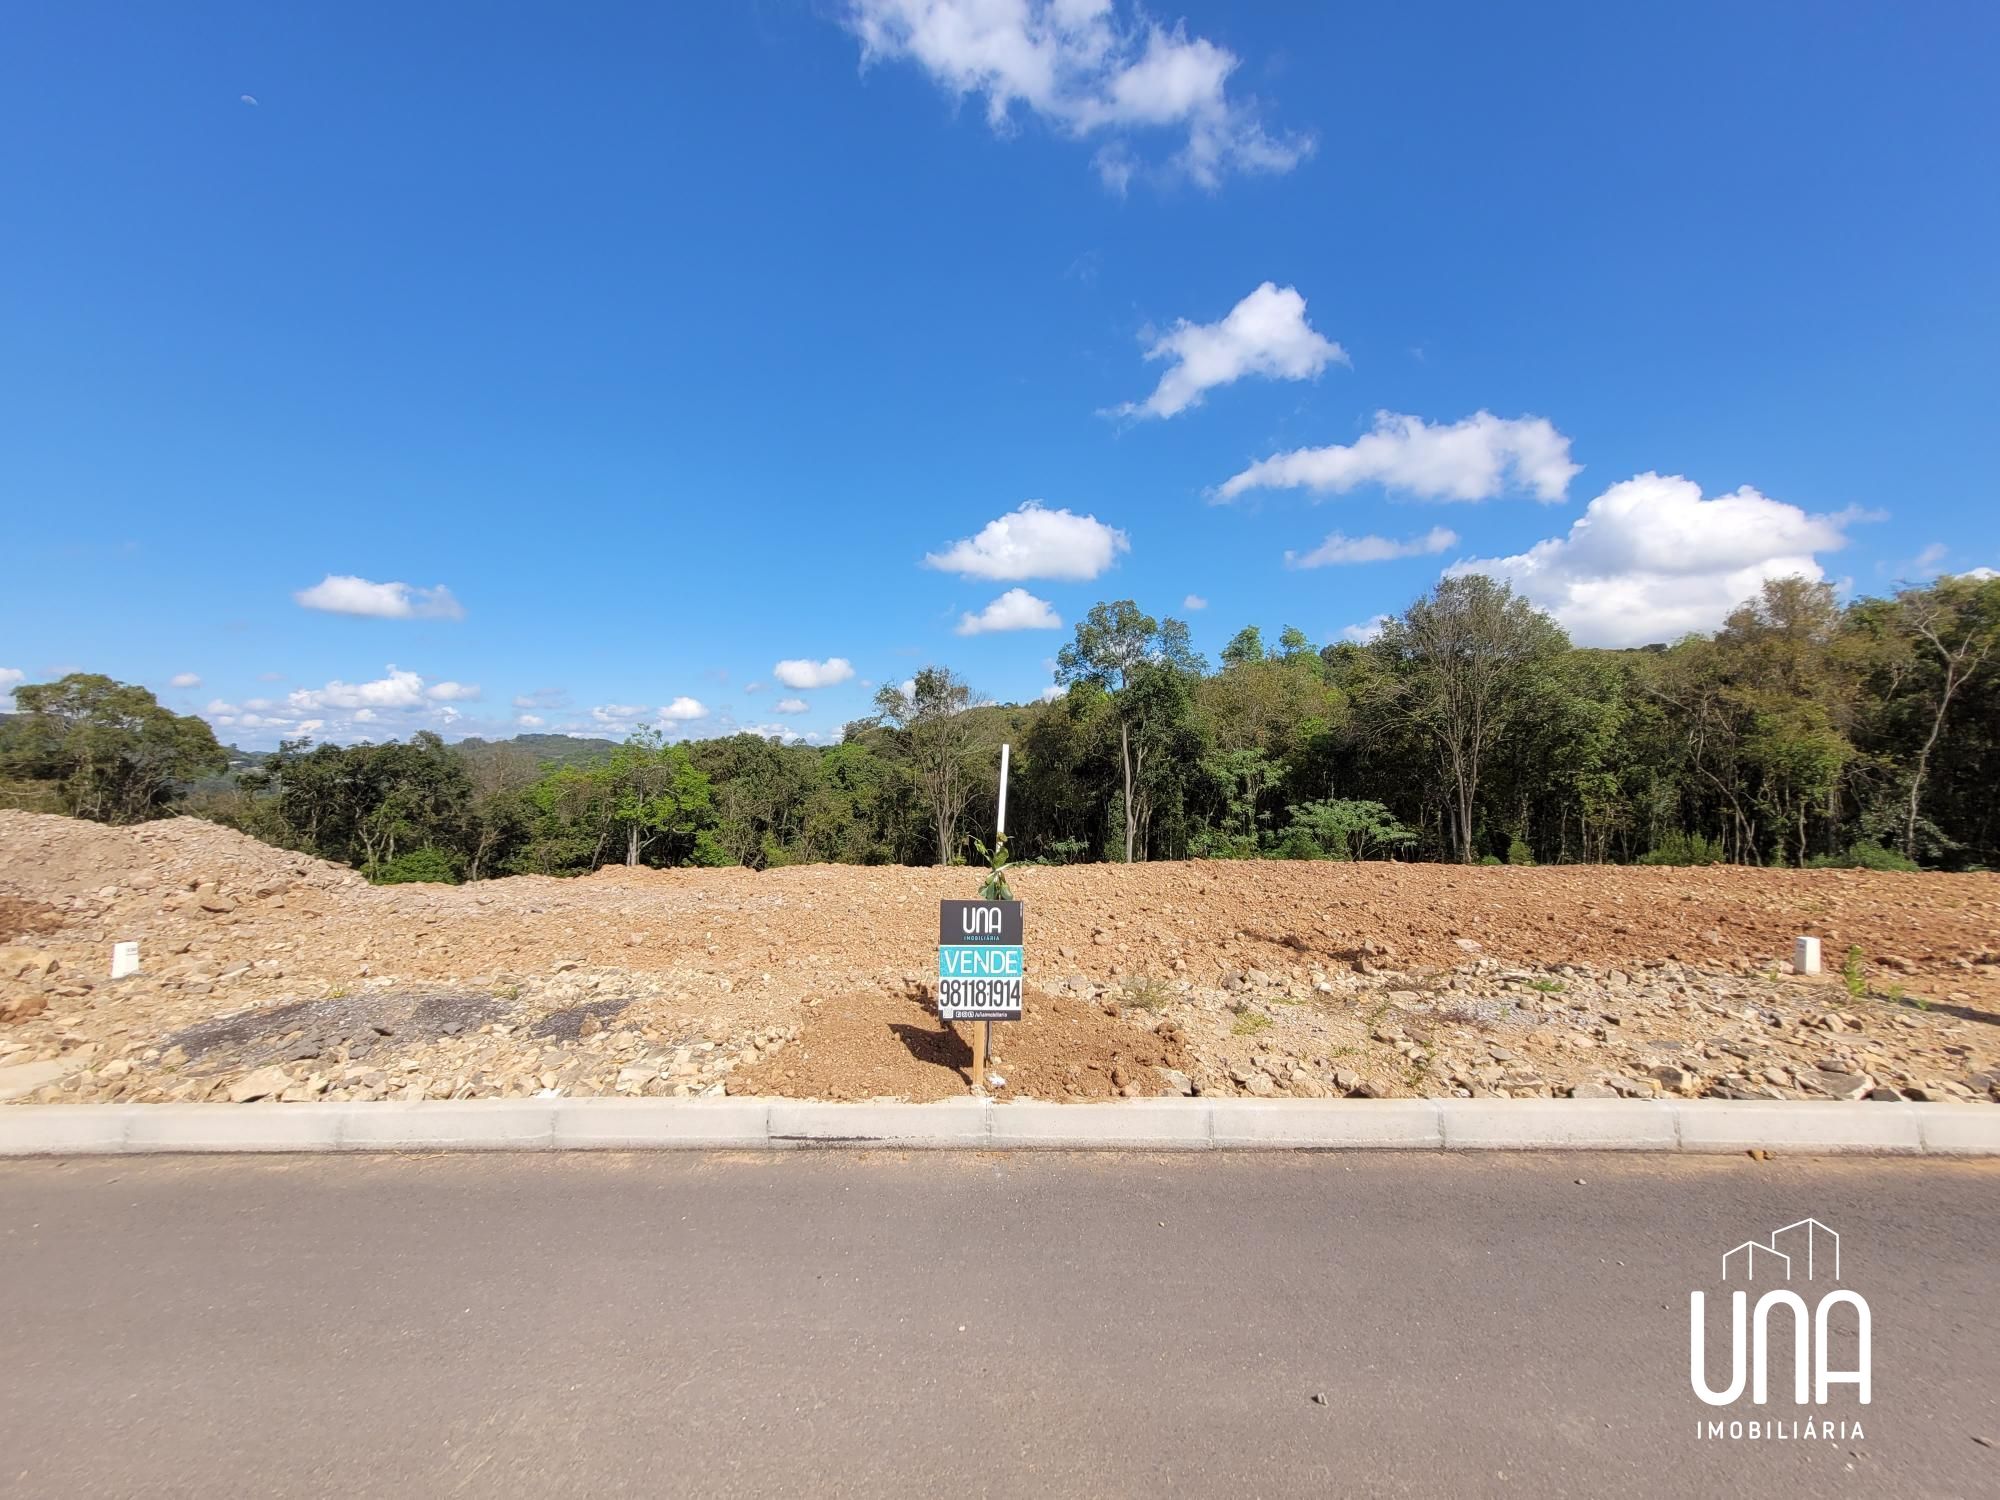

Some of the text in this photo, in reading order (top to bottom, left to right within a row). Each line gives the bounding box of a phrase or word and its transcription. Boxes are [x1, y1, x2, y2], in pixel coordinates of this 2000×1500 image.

[963, 907, 1002, 934] UNA
[944, 950, 1018, 974] VENDE
[940, 979, 1020, 1007] 981181914
